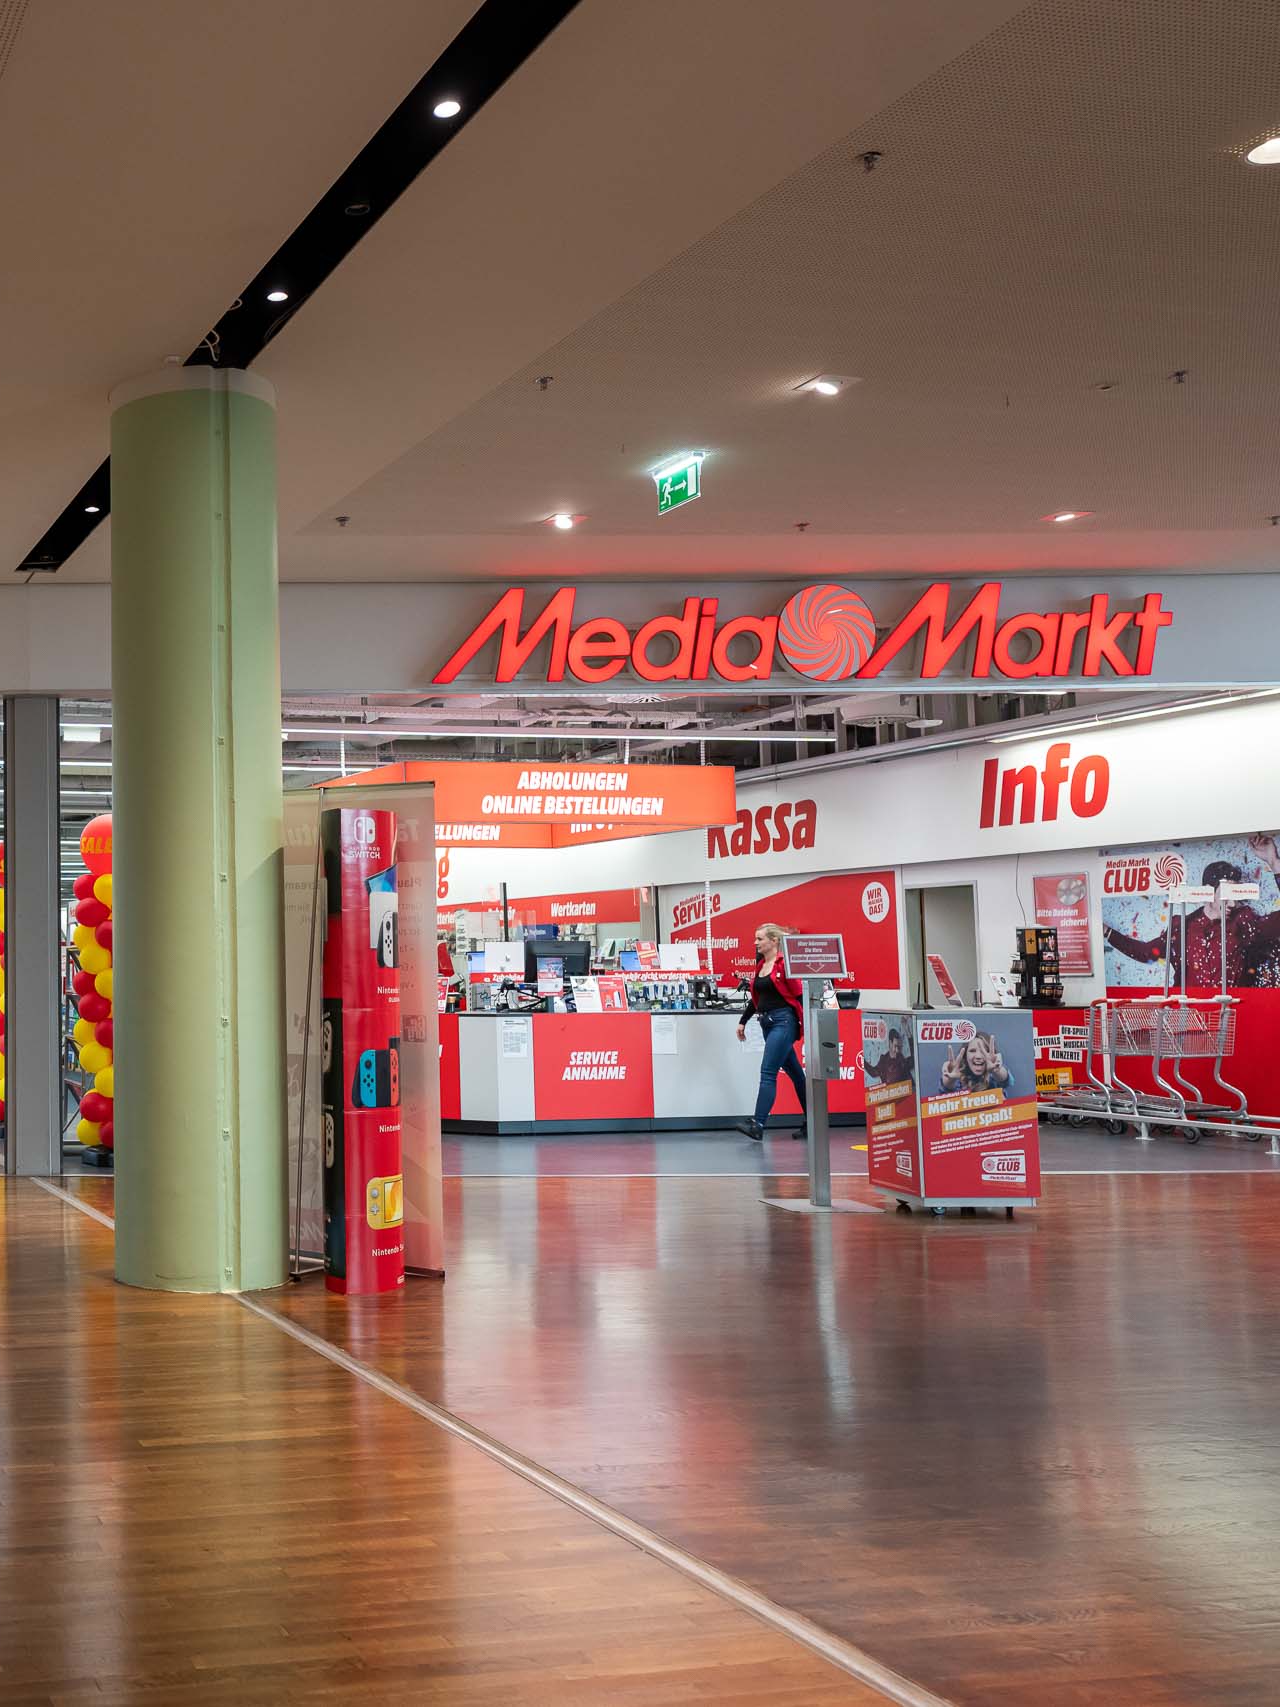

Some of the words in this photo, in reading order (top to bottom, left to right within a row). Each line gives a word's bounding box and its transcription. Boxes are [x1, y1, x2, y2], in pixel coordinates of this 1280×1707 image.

[432, 585, 779, 685] Media
[855, 581, 1173, 680] Markt
[517, 771, 629, 791] ABHOLUNGEN
[979, 742, 1110, 830] Info
[481, 795, 542, 814] ONLINE
[544, 797, 664, 815] BESTELLUNGEN
[434, 824, 501, 840] ELLUNGEN
[350, 851, 381, 859] SWITCH
[1105, 858, 1128, 868] Media
[1128, 857, 1150, 867] Markt
[1103, 867, 1151, 894] CLUB
[867, 887, 882, 900] WIR
[550, 902, 596, 917] Wertkarten
[869, 903, 884, 916] DAS!
[1036, 907, 1052, 917] Bitte
[1052, 907, 1079, 917] Dateien
[734, 957, 756, 968] Lieferun
[863, 1026, 878, 1039] CLUB
[921, 1027, 953, 1041] CLUB
[1033, 1037, 1061, 1047] FESTIVALS
[569, 1051, 618, 1065] SERVICE
[1051, 1050, 1080, 1061] KONZERTE
[562, 1066, 626, 1080] ANNAHME
[1035, 1073, 1056, 1086] icket
[928, 1101, 961, 1115] Mehr
[961, 1093, 999, 1109] Treue,
[944, 1113, 977, 1132] mehr
[978, 1107, 1013, 1127] Spaß!
[996, 1162, 1020, 1172] CLUB
[372, 1246, 400, 1257] Nintendo
